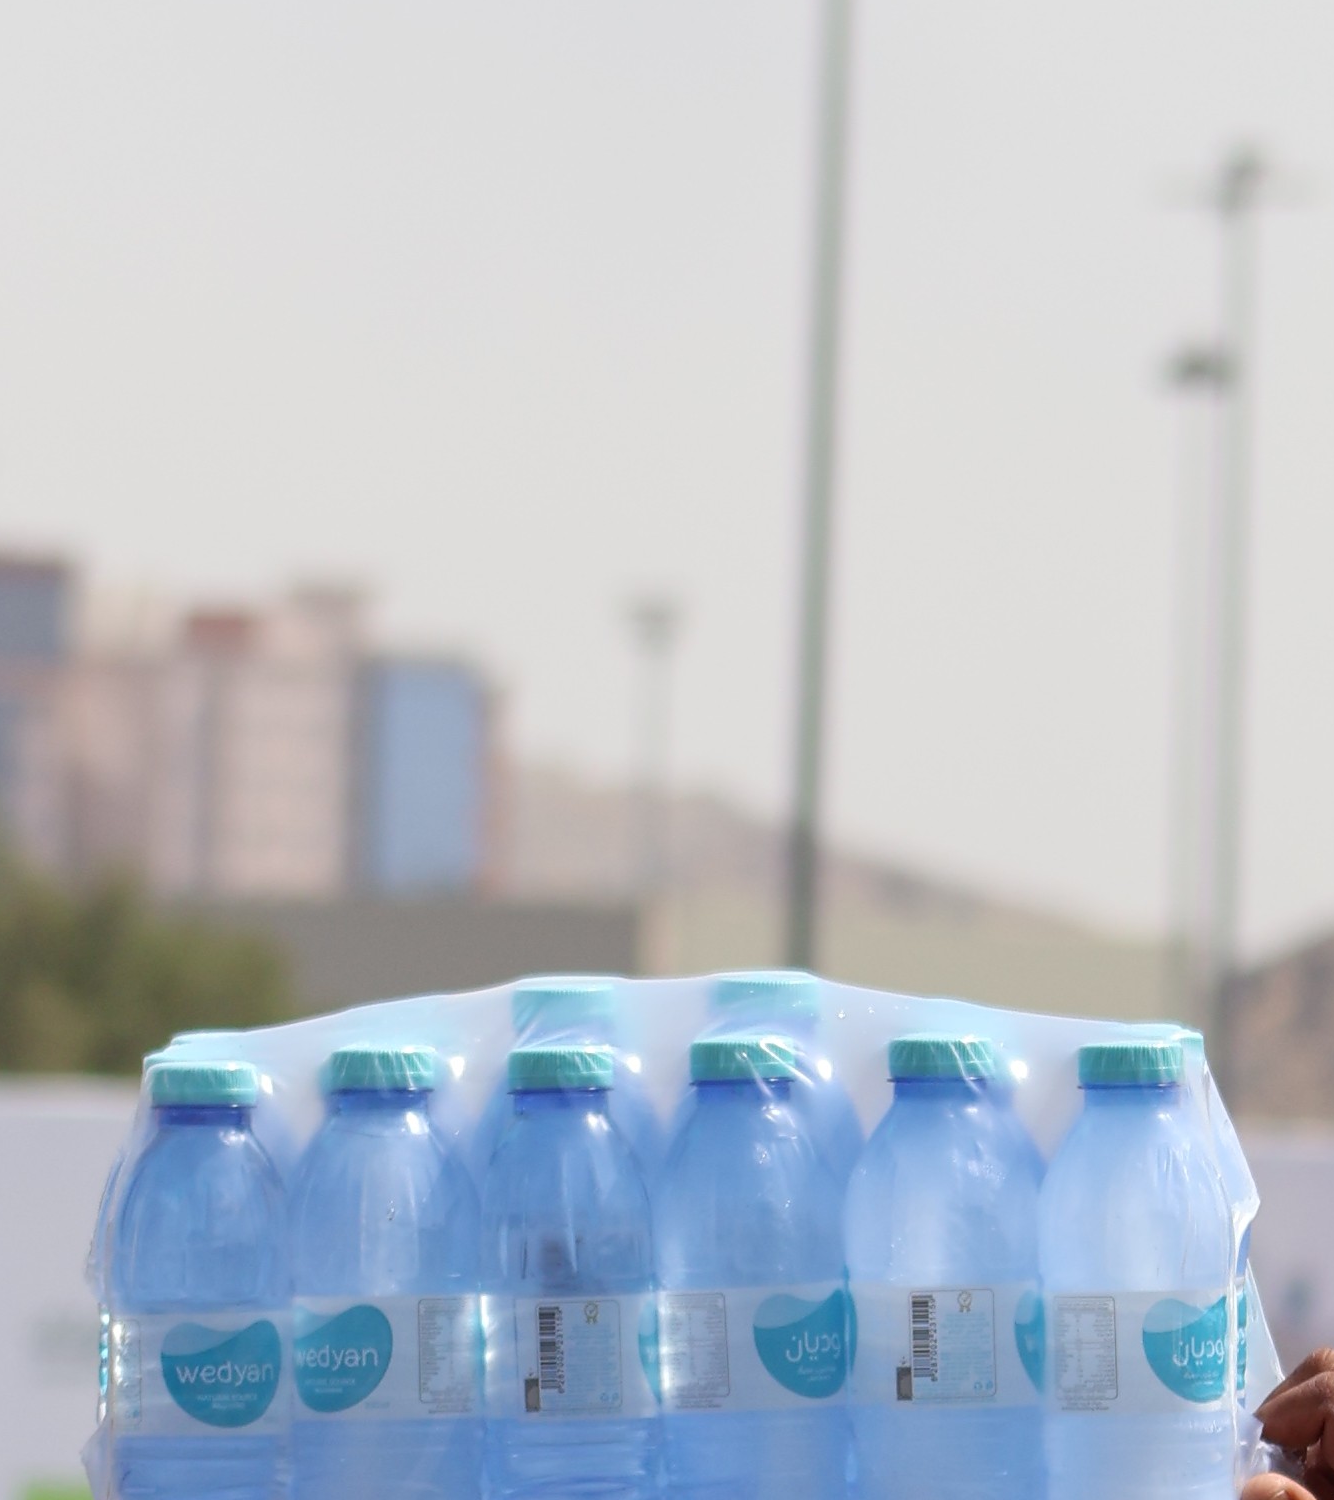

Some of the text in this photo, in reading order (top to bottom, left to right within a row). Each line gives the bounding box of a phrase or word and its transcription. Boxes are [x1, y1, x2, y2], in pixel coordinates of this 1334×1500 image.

[785, 1331, 841, 1363] وديان
[1172, 1336, 1225, 1367] وديان
[175, 1360, 274, 1387] wedyan
